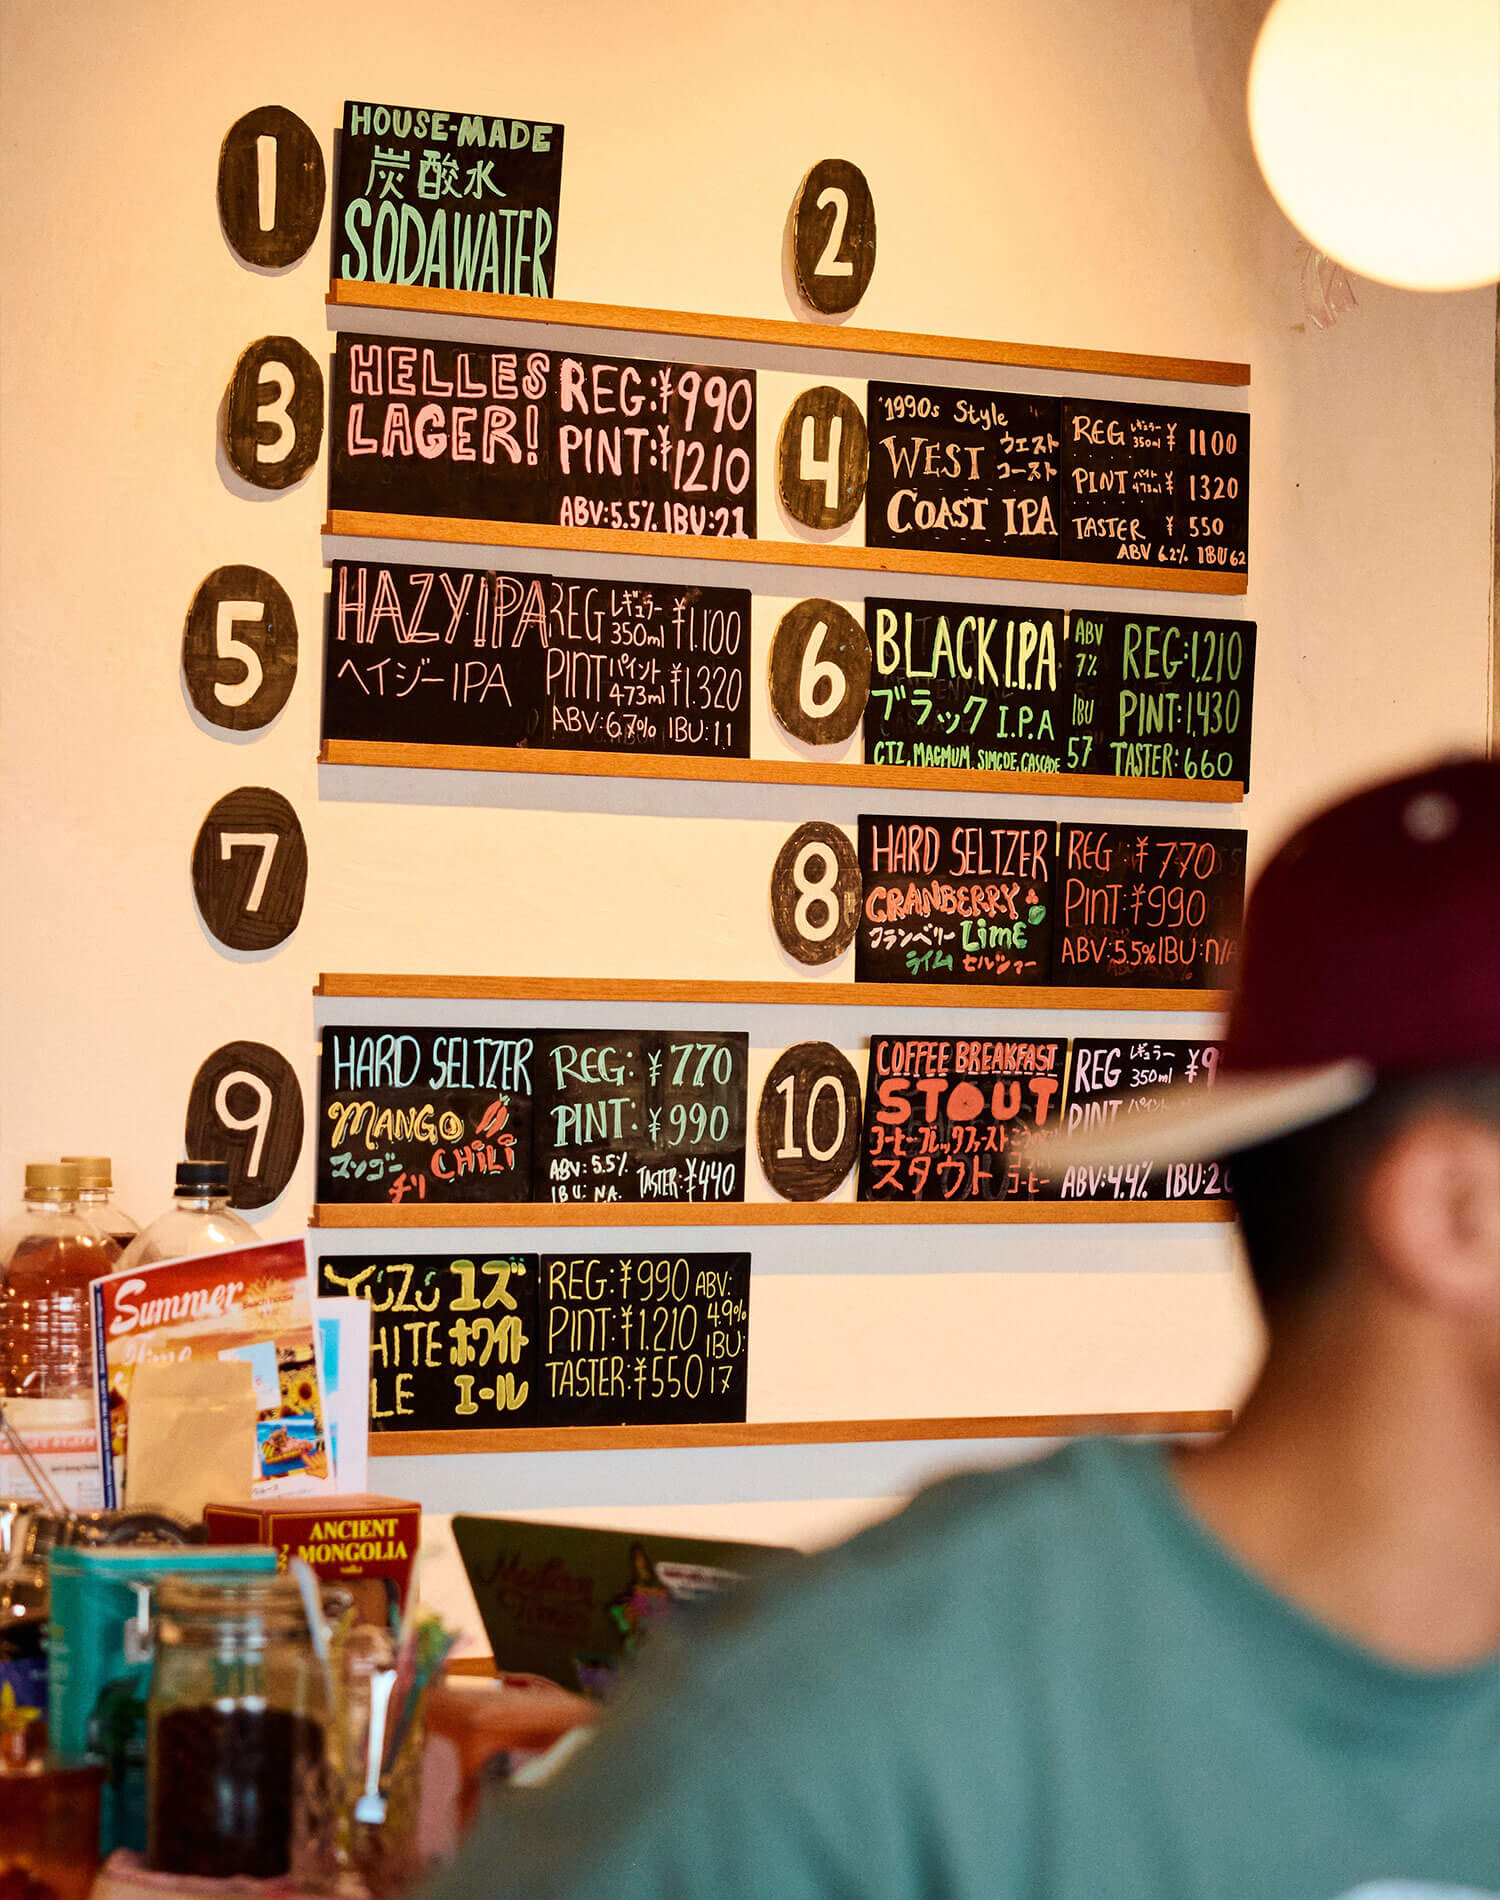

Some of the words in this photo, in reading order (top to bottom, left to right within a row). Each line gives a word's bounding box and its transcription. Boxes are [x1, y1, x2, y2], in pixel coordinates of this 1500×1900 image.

[351, 104, 553, 152] HOUSE-MADE
[257, 136, 277, 232] 1
[364, 144, 507, 200] 炭酸水
[814, 187, 853, 276] 2
[350, 344, 550, 401] HELLES
[256, 361, 296, 464] 3
[347, 403, 539, 466] LAGER!
[953, 399, 1008, 431] Style
[1072, 416, 1125, 445] REG
[800, 415, 842, 509] 4
[879, 435, 985, 480] WEST
[1000, 431, 1059, 454] ウエスト
[1133, 436, 1160, 448] 350ml
[997, 461, 1058, 482] コースト
[1072, 468, 1128, 495] PINT
[887, 489, 989, 534] COAST
[1003, 495, 1059, 536] IPA
[1072, 517, 1146, 540] TASTER
[1116, 543, 1151, 561] ABV
[549, 582, 604, 643] REG
[611, 589, 662, 619] レギュラー
[611, 622, 665, 648] 350ml
[876, 608, 999, 687] BLACK
[1076, 618, 1103, 645] ABV
[214, 601, 265, 707] 5
[610, 654, 660, 686] パイント
[800, 620, 846, 718] 6
[1076, 654, 1097, 677] 7%
[609, 684, 665, 707] 473ml
[871, 685, 987, 734] ブラック
[1072, 694, 1094, 725] IBU
[1067, 736, 1093, 769] 57
[220, 832, 279, 912] 7
[872, 825, 939, 874] HARD
[950, 827, 1048, 882] SELTZER
[793, 841, 839, 942] 8
[865, 879, 1020, 922] CRANBERRY
[906, 950, 953, 975] ライム
[334, 1035, 420, 1090] HARD
[430, 1036, 533, 1095] SELTZER
[551, 1045, 633, 1089] REG:
[877, 1041, 950, 1074] COFFEE
[955, 1041, 1058, 1073] BREAKFAST
[1075, 1048, 1121, 1093] REG
[1130, 1042, 1175, 1060] レギュラー
[1130, 1067, 1172, 1087] 350ml
[215, 1070, 272, 1177] 9
[551, 1098, 637, 1146] PINT:
[776, 1075, 846, 1162] 10
[876, 1078, 1058, 1126] STOUT
[328, 1101, 464, 1150] MANGO
[389, 1172, 426, 1203] チリ
[872, 1155, 992, 1198] スタウト
[109, 1279, 243, 1334] Summer
[707, 1300, 747, 1327] 4.9%
[369, 1321, 442, 1368] HITE
[449, 1315, 529, 1367] ホワイト
[371, 1373, 415, 1418] LE
[455, 1372, 529, 1415] エール
[710, 1366, 732, 1394] 17
[309, 1519, 399, 1540] ANCIENT
[299, 1541, 408, 1563] MONGOLIA
